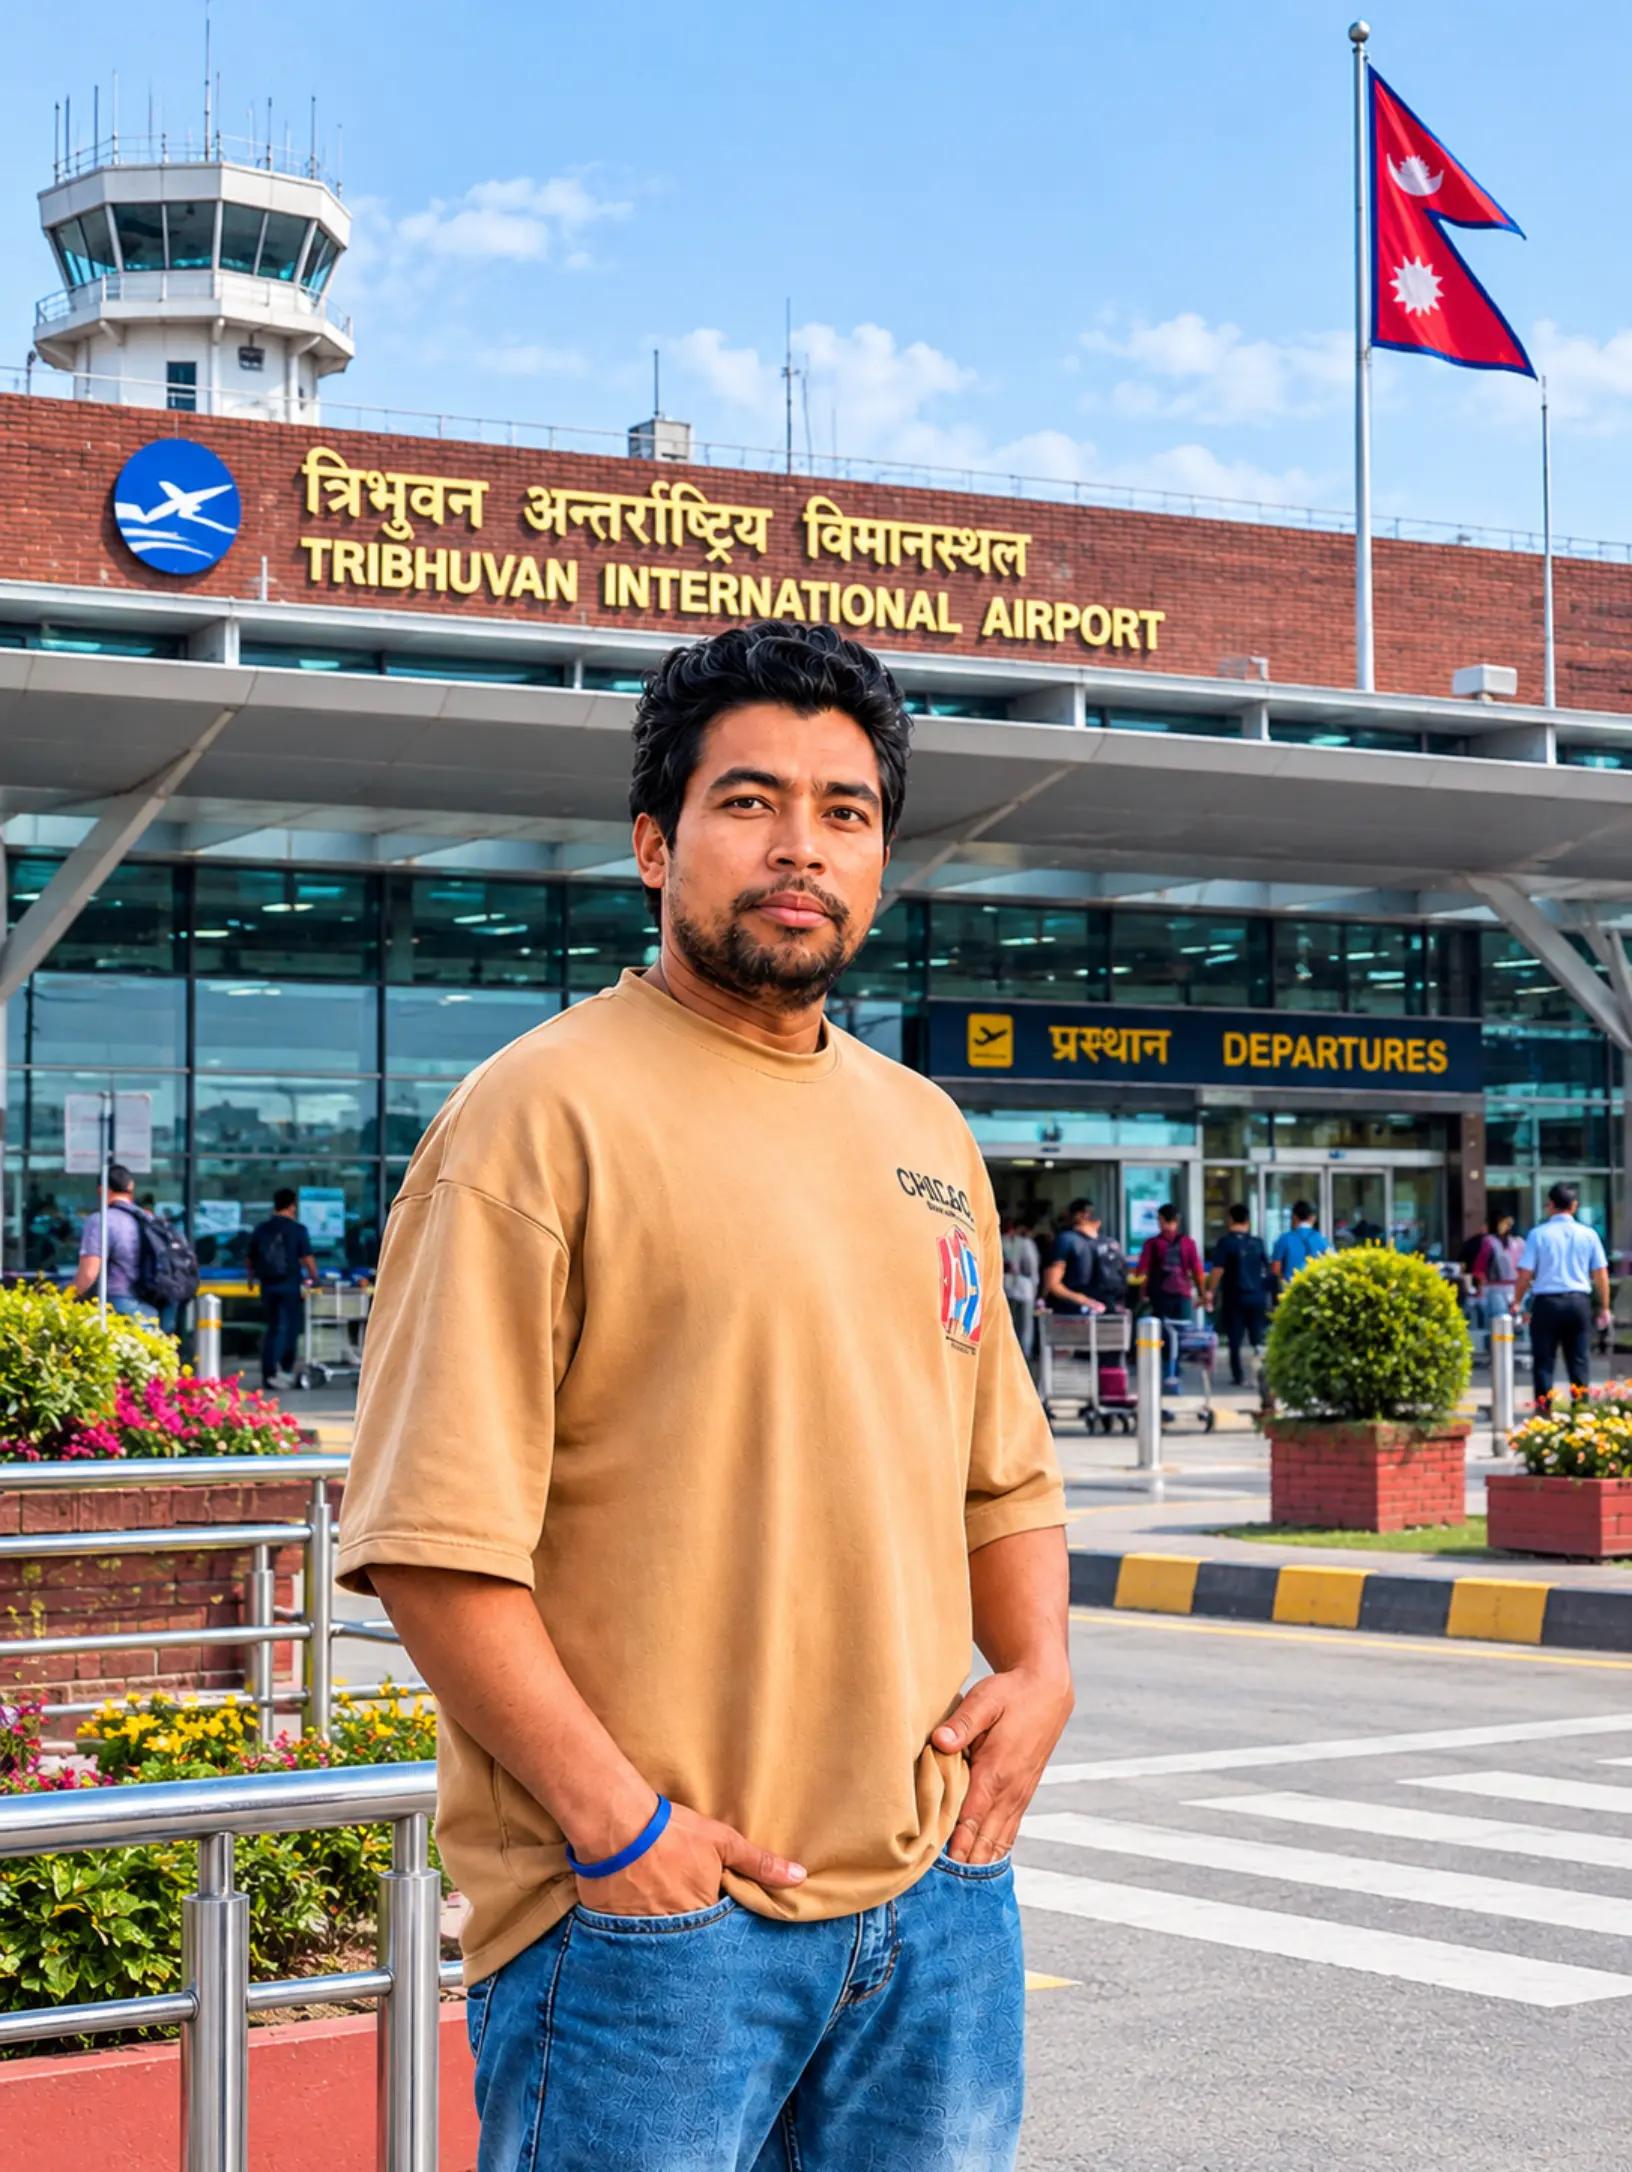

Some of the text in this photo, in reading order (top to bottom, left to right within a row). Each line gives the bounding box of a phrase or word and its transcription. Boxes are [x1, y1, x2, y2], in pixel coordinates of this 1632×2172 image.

[301, 446, 489, 541] त्रिभुवन
[803, 495, 1032, 578] विमानस्थल
[300, 537, 1166, 651] TRIBHUVAN INTERNATIONAL AIRPORT
[1048, 1025, 1171, 1065] प्रस्थान
[1223, 1031, 1448, 1074] DEPARTURES
